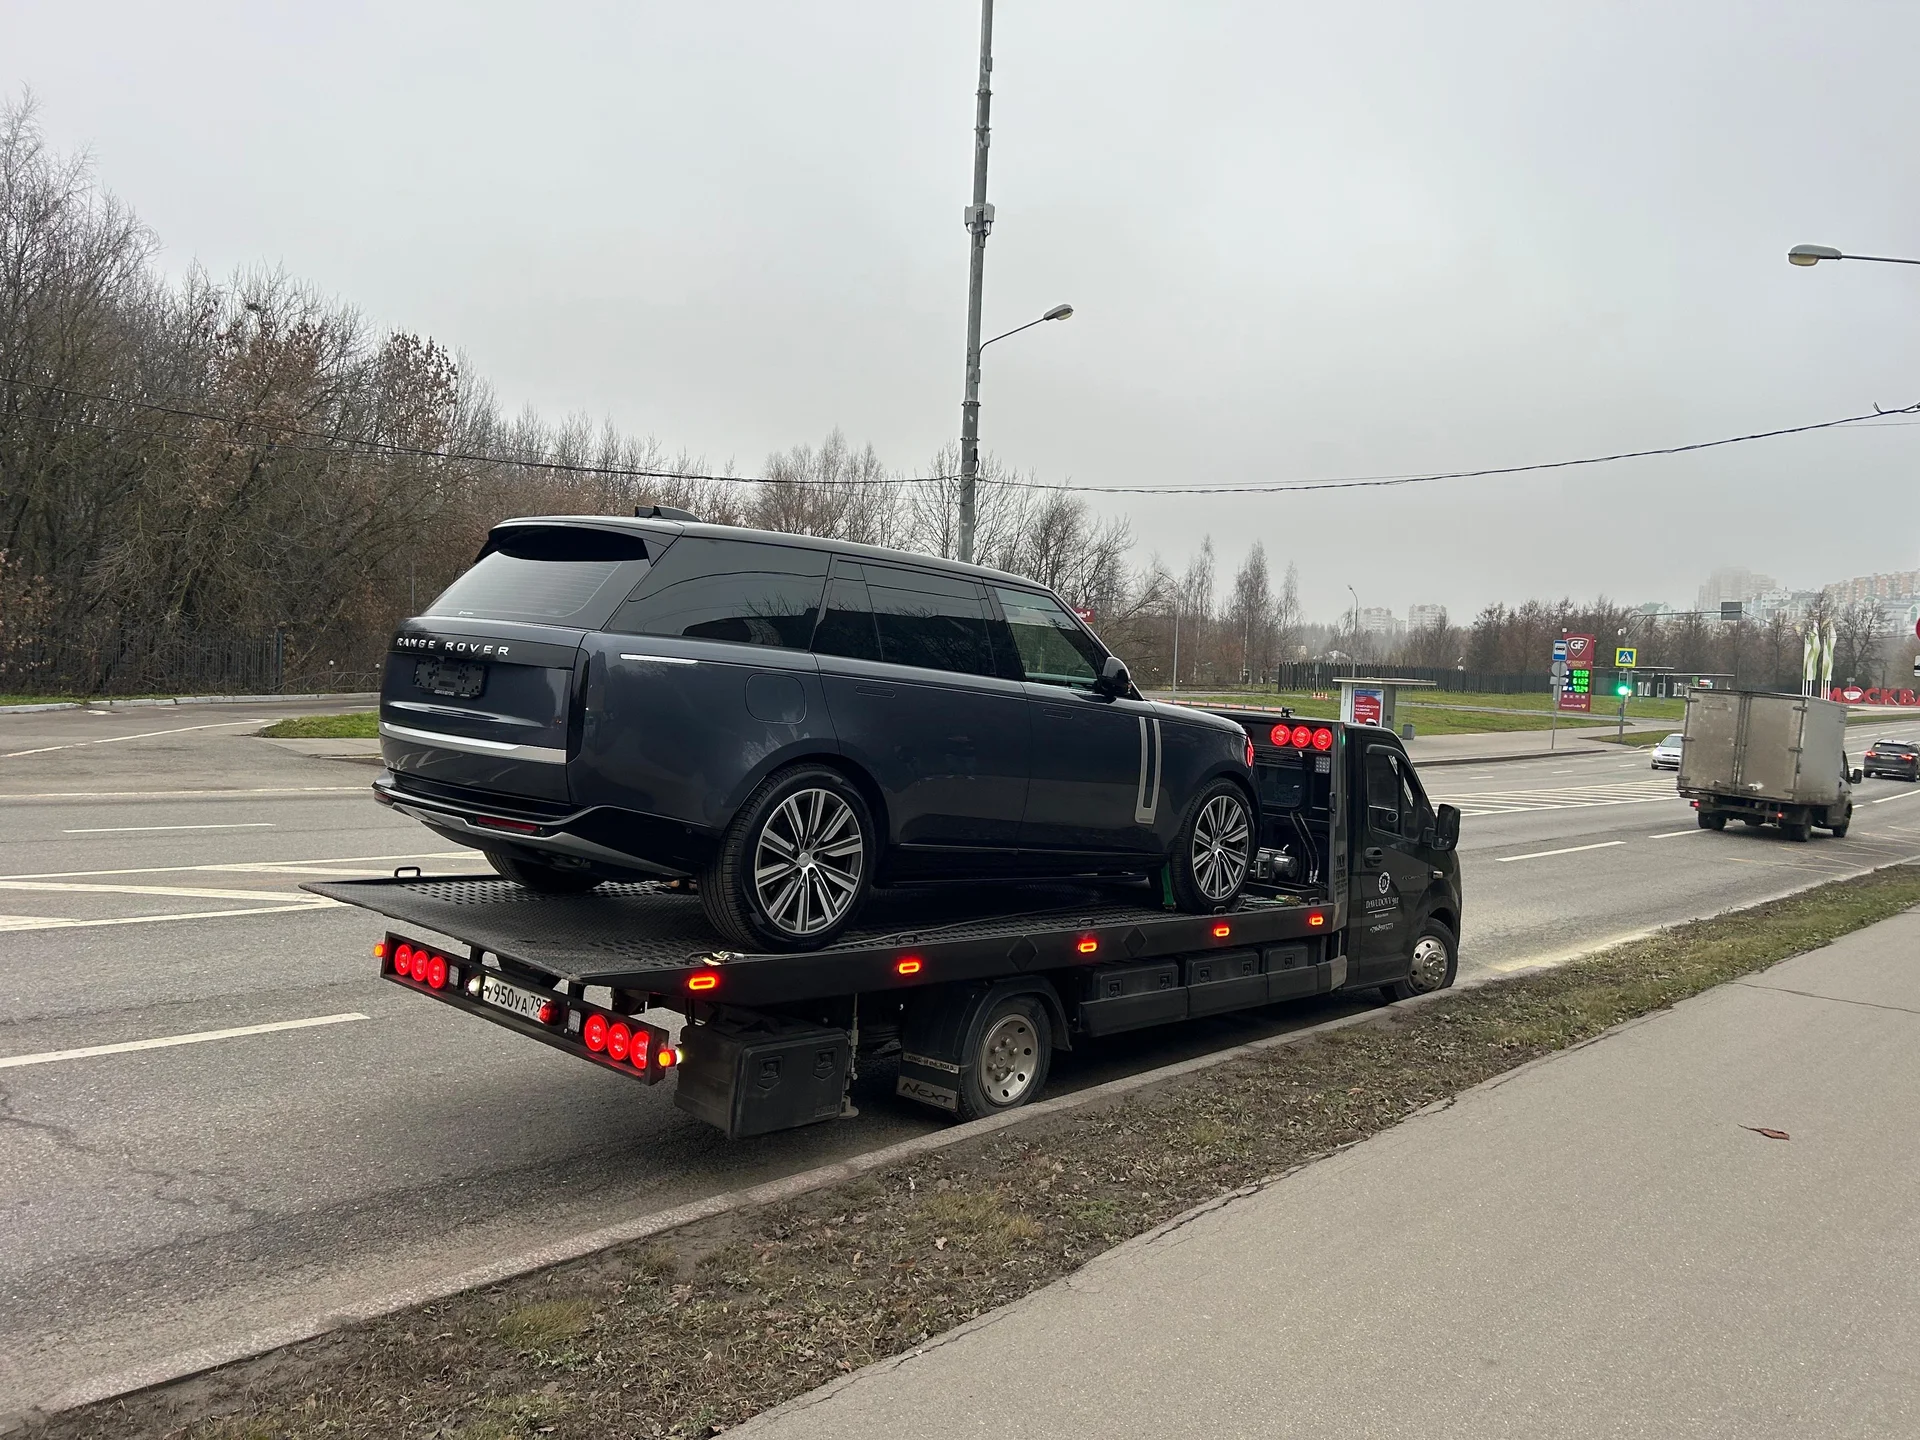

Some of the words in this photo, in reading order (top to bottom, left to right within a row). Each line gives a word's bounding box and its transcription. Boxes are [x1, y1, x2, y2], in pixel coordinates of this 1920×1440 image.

[396, 637, 436, 649] RANGE
[444, 641, 510, 656] ROVER
[1570, 641, 1584, 649] GF
